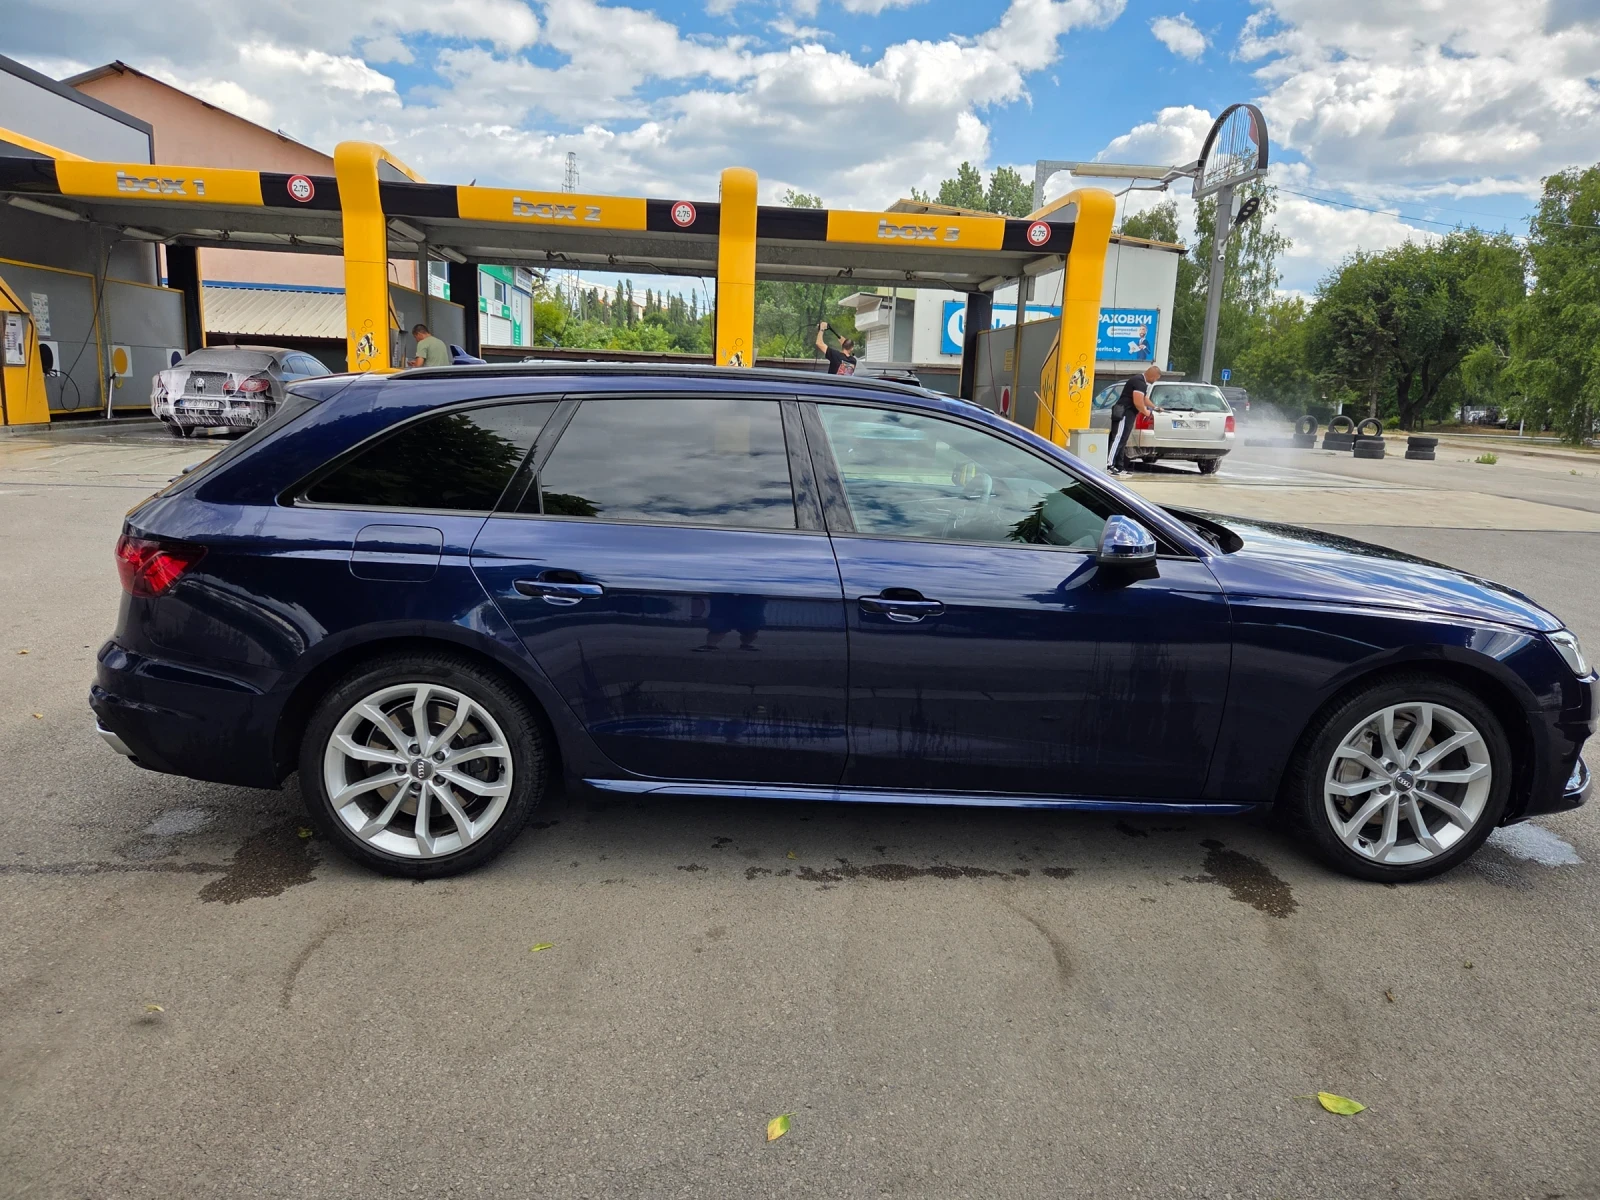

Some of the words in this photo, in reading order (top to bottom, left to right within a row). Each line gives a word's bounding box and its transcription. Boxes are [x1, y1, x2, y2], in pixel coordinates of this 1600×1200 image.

[116, 171, 186, 195] box
[193, 179, 206, 195] 1
[293, 184, 309, 193] 2.75
[513, 196, 577, 221] box
[584, 206, 602, 222] 2
[676, 210, 691, 218] 2.75
[877, 219, 939, 241] box
[943, 227, 961, 242] 3
[1031, 229, 1046, 238] 2.75
[1098, 313, 1153, 325] РАХОВКИ
